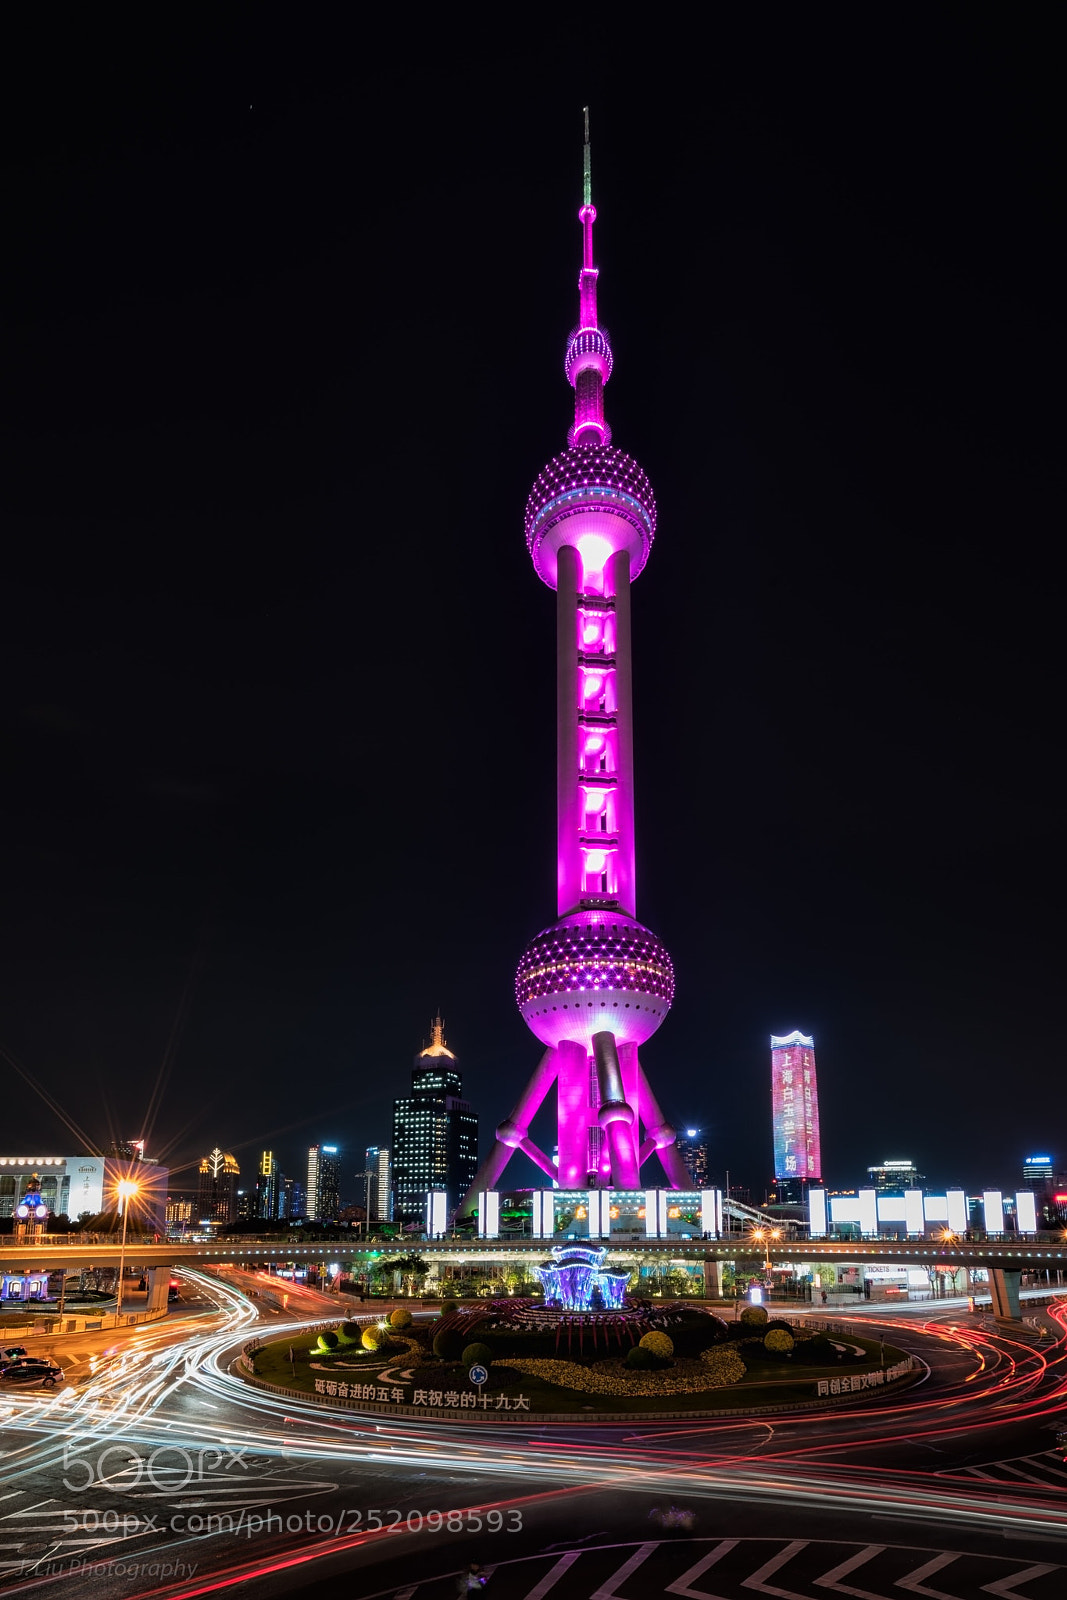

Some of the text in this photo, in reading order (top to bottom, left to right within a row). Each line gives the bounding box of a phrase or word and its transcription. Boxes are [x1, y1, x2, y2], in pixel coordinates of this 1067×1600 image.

[782, 1053, 797, 1172] 上海白玉兰广场
[314, 1378, 530, 1410] 砥砺奋进的五年 庆祝党的十九大
